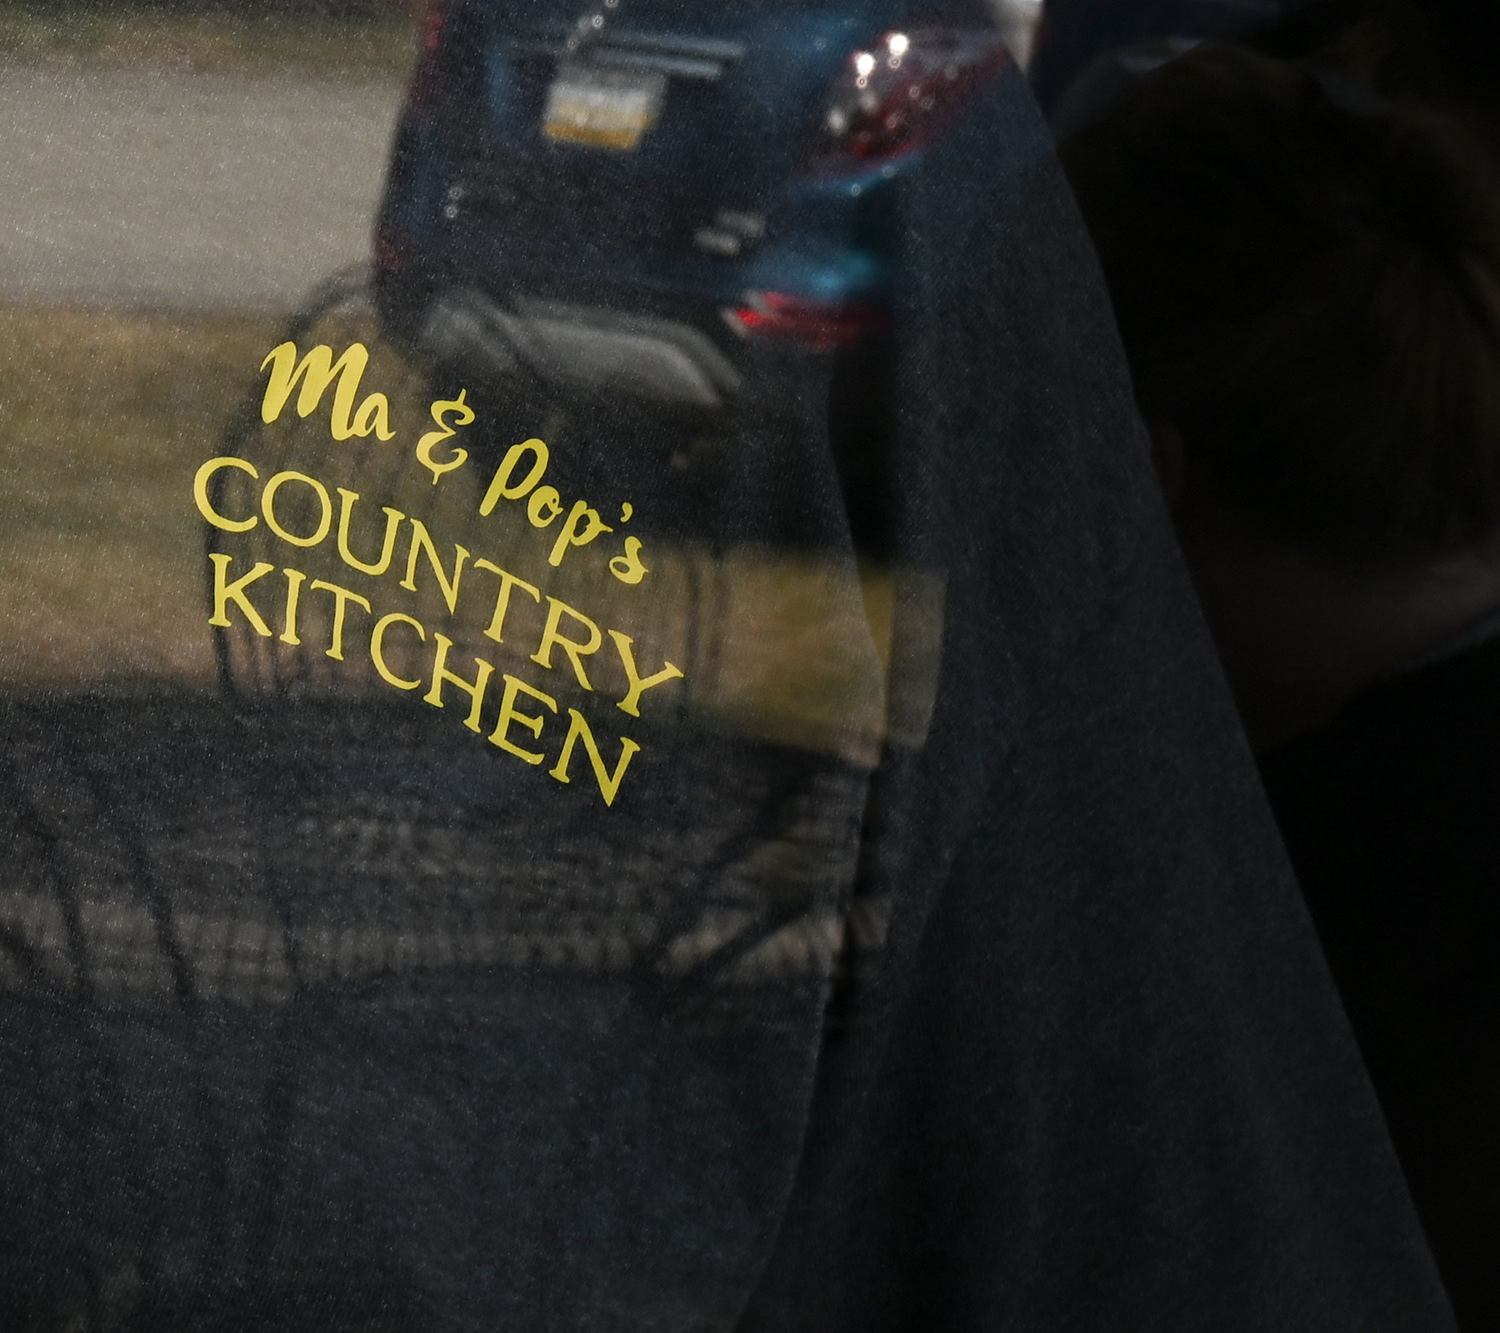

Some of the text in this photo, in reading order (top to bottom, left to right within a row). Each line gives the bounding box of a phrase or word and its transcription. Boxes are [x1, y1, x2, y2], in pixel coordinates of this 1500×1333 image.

[194, 456, 684, 718] COUNTRY
[260, 341, 649, 585] Ma & Pop's
[208, 552, 641, 807] KITCHEN
